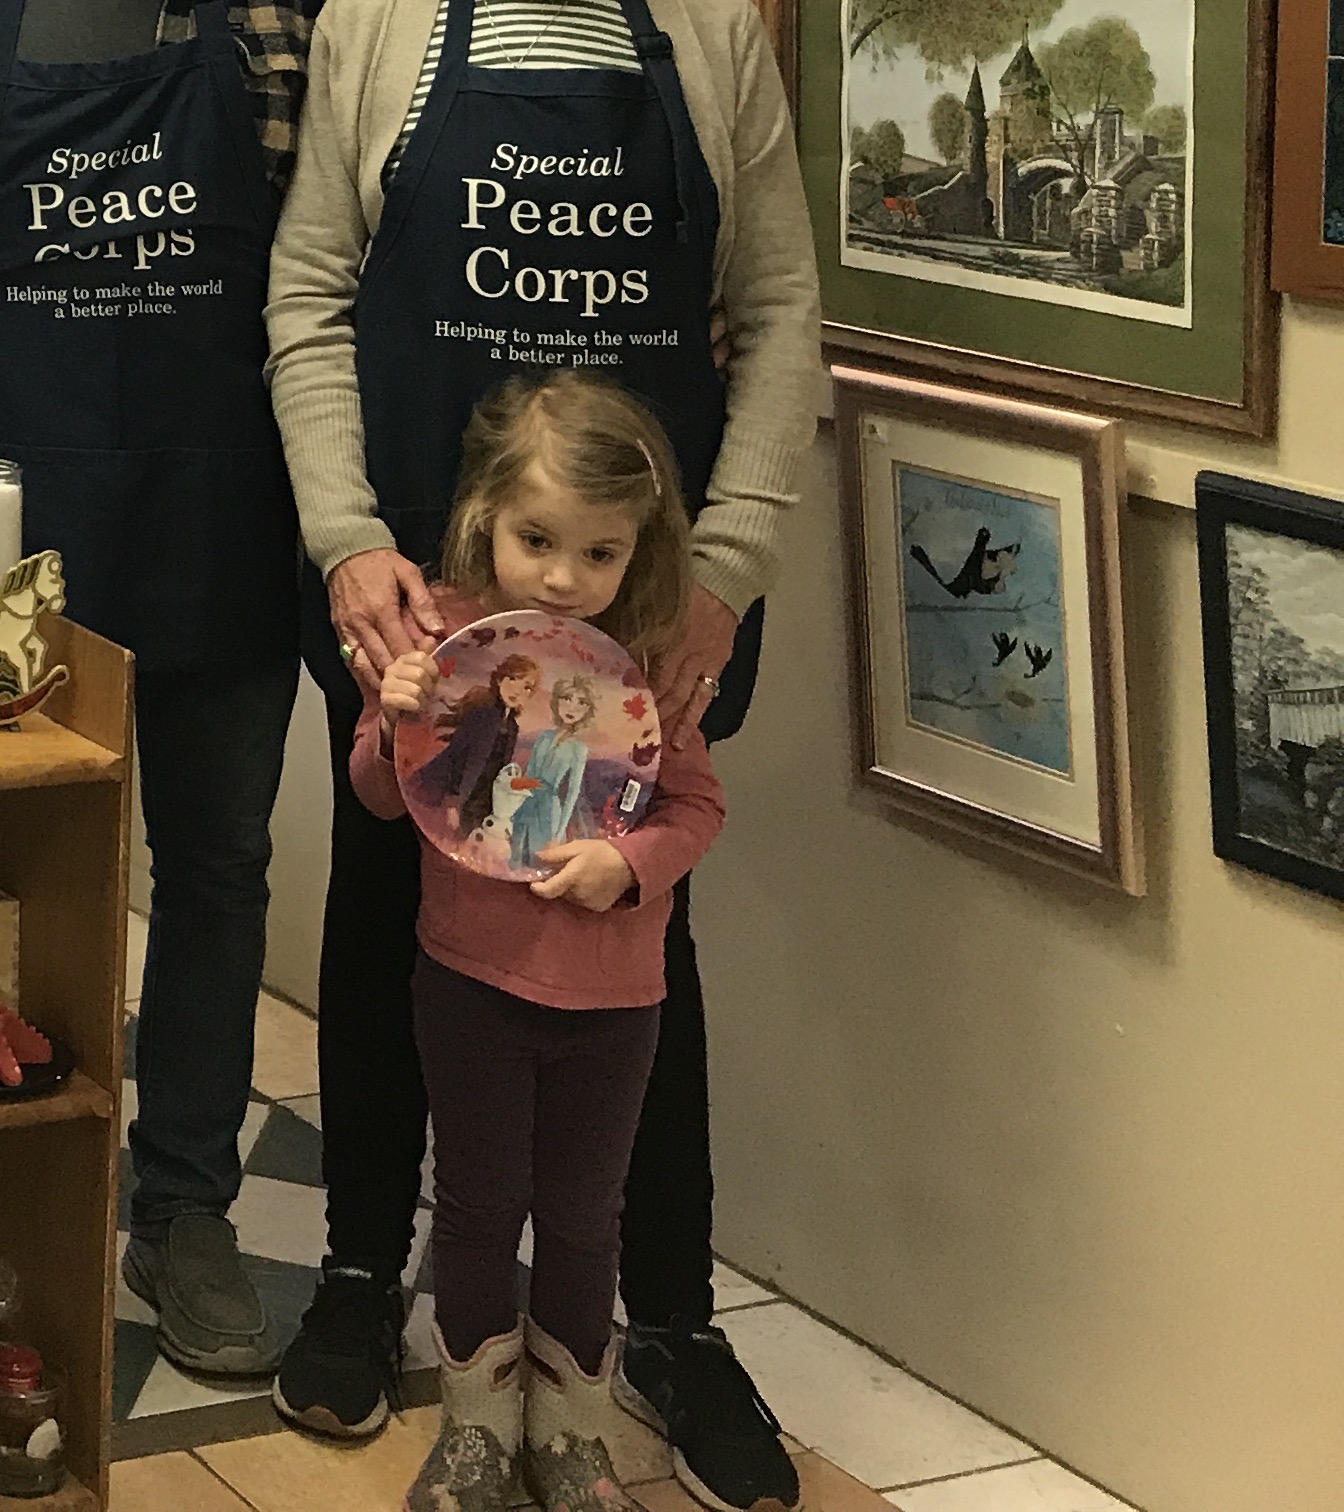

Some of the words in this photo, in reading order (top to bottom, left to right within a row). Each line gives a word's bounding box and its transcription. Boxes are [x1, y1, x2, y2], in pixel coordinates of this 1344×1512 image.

[47, 131, 162, 179] Special
[490, 143, 625, 180] Special
[22, 181, 197, 231] Peace
[461, 177, 653, 238] Peace
[6, 285, 68, 304] Helping
[73, 286, 90, 300] to
[95, 283, 142, 299] make
[147, 281, 175, 297] the
[181, 279, 223, 295] world
[465, 246, 649, 317] Corps
[54, 307, 65, 319] a
[71, 303, 122, 318] better
[127, 299, 177, 317] place.
[434, 320, 507, 344] Helping
[513, 328, 530, 343] to
[537, 329, 588, 346] make
[594, 330, 623, 346] the
[628, 329, 679, 346] world
[490, 347, 502, 360] a
[509, 345, 565, 364] better
[572, 350, 624, 368] place.
